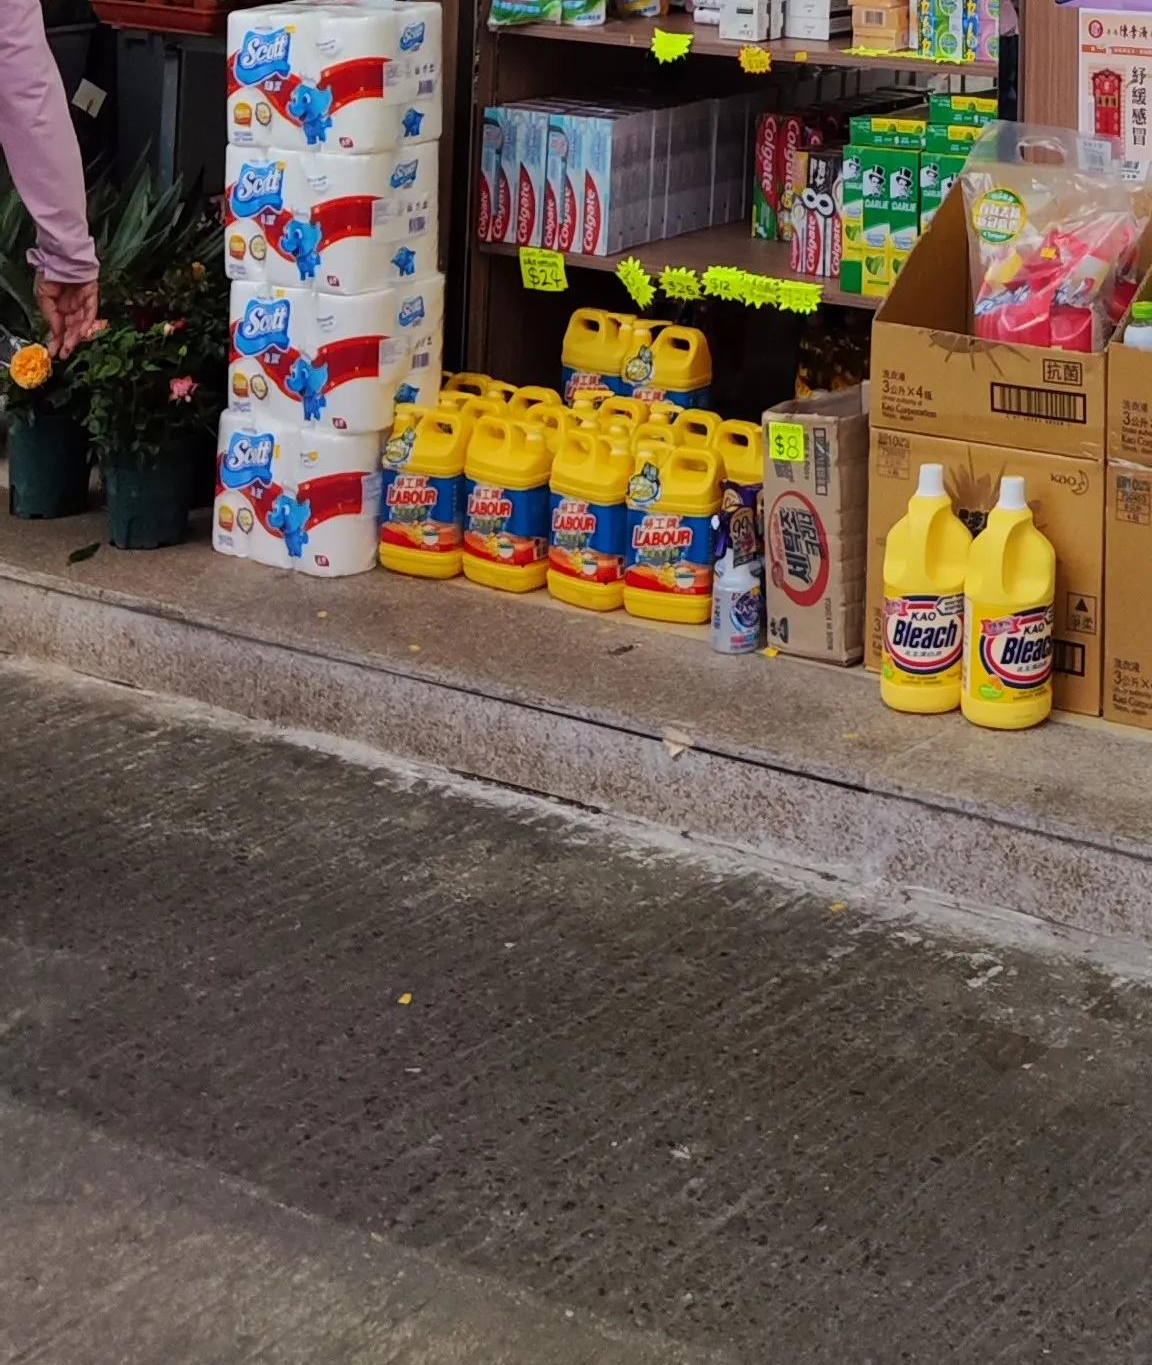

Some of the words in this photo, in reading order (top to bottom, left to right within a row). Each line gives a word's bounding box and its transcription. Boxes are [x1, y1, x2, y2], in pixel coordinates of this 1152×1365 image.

[242, 33, 289, 69] Scott
[761, 115, 777, 193] Colgate
[238, 170, 282, 201] Scott
[517, 181, 531, 243] Colgate
[583, 188, 597, 252] Colgate
[804, 215, 817, 273] Colgate
[246, 305, 288, 336] Scott
[230, 437, 273, 467] Scott
[774, 432, 799, 459] $8
[388, 488, 437, 504] LABOUR
[469, 500, 512, 516] LABOUR
[554, 514, 597, 532] LABOUR
[635, 527, 694, 547] LABOUR
[909, 610, 937, 622] KAO
[1023, 623, 1045, 636] KAO
[892, 619, 958, 650] Bleach
[1001, 635, 1053, 665] Bleac
